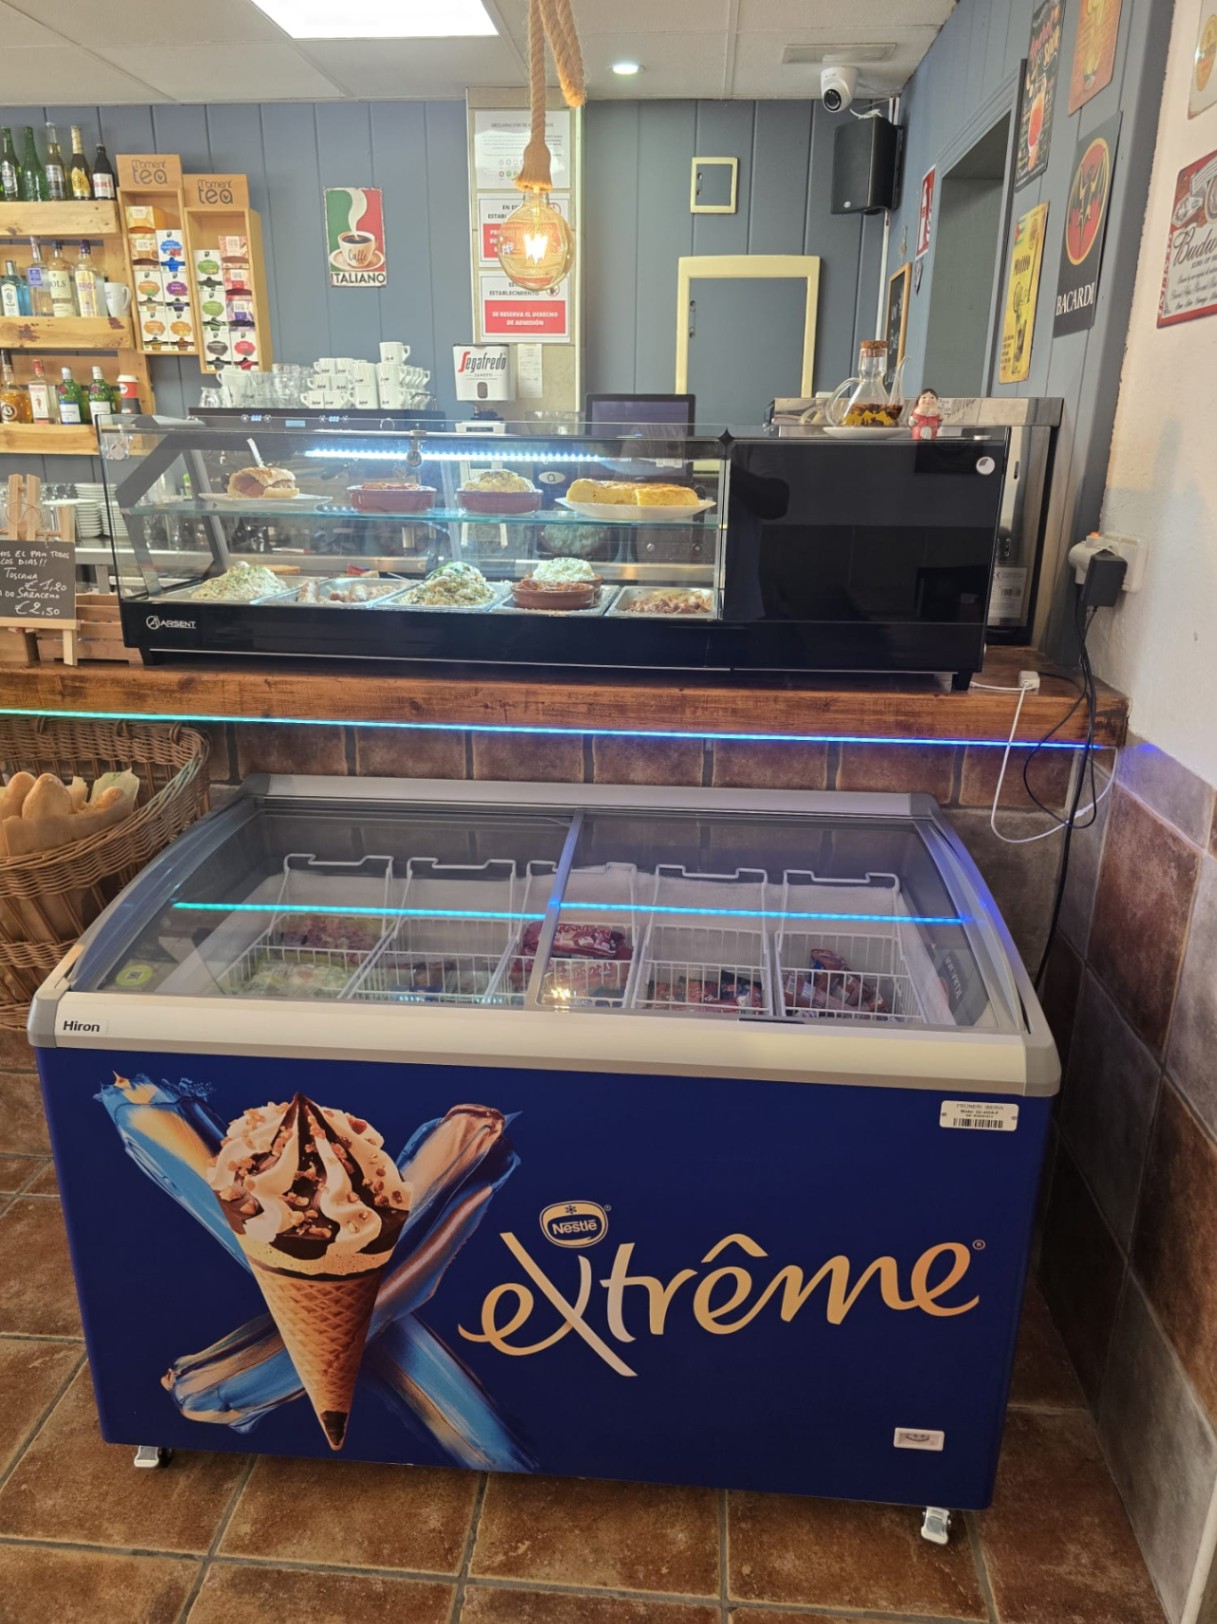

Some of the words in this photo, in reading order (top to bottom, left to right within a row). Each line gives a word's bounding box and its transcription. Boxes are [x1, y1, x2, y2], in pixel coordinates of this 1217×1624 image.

[132, 166, 168, 185] tea
[198, 186, 233, 205] tea
[331, 272, 386, 284] ITALIANO
[1055, 282, 1095, 316] BACARDI
[457, 351, 507, 373] Segafredo
[63, 1020, 100, 1032] Hiron
